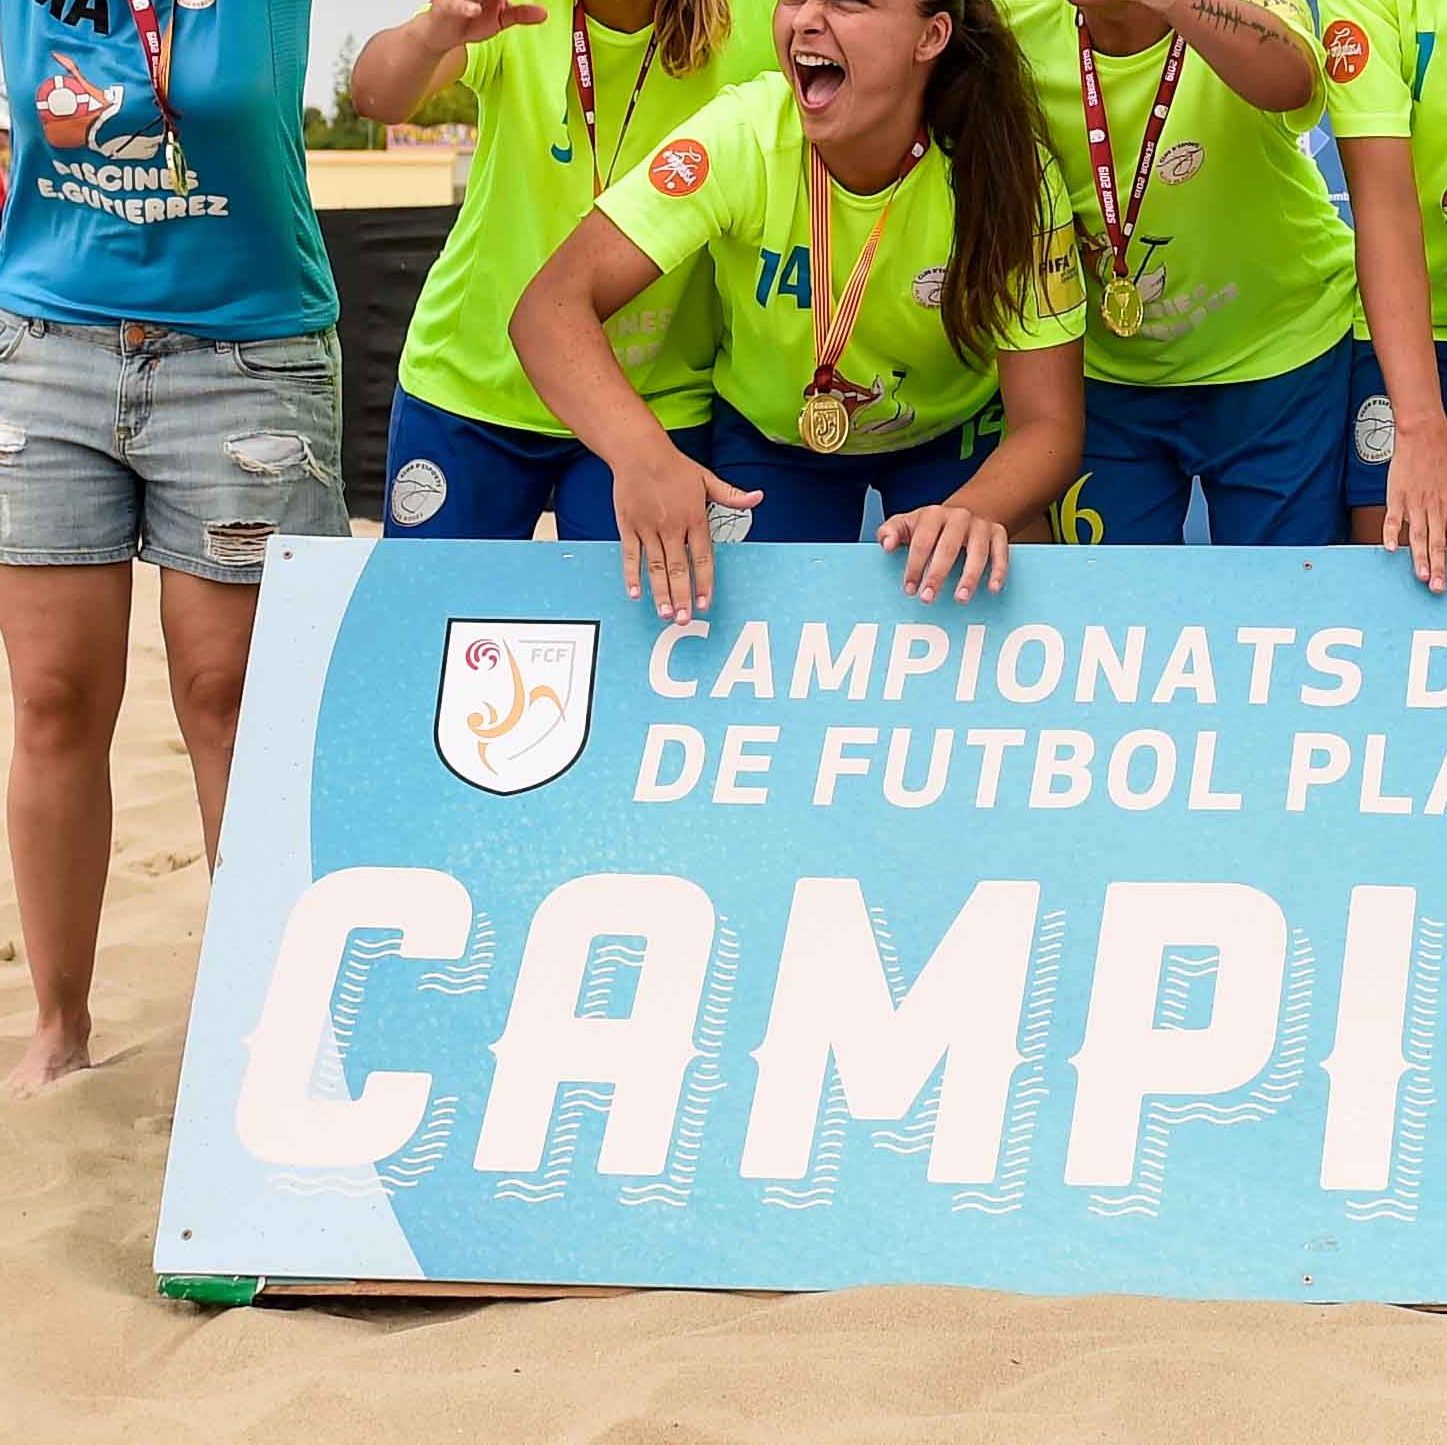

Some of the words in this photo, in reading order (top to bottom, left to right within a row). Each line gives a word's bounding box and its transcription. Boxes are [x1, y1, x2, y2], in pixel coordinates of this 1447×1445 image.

[1140, 140, 1155, 176] SENIOR
[1098, 166, 1112, 189] 2019
[1101, 189, 1117, 225] SENIOR
[755, 245, 812, 309] 14
[531, 647, 570, 664] FCF
[648, 619, 1364, 707] CAMPIONATS
[632, 723, 781, 806] DE
[812, 725, 1243, 811] FUTBOL
